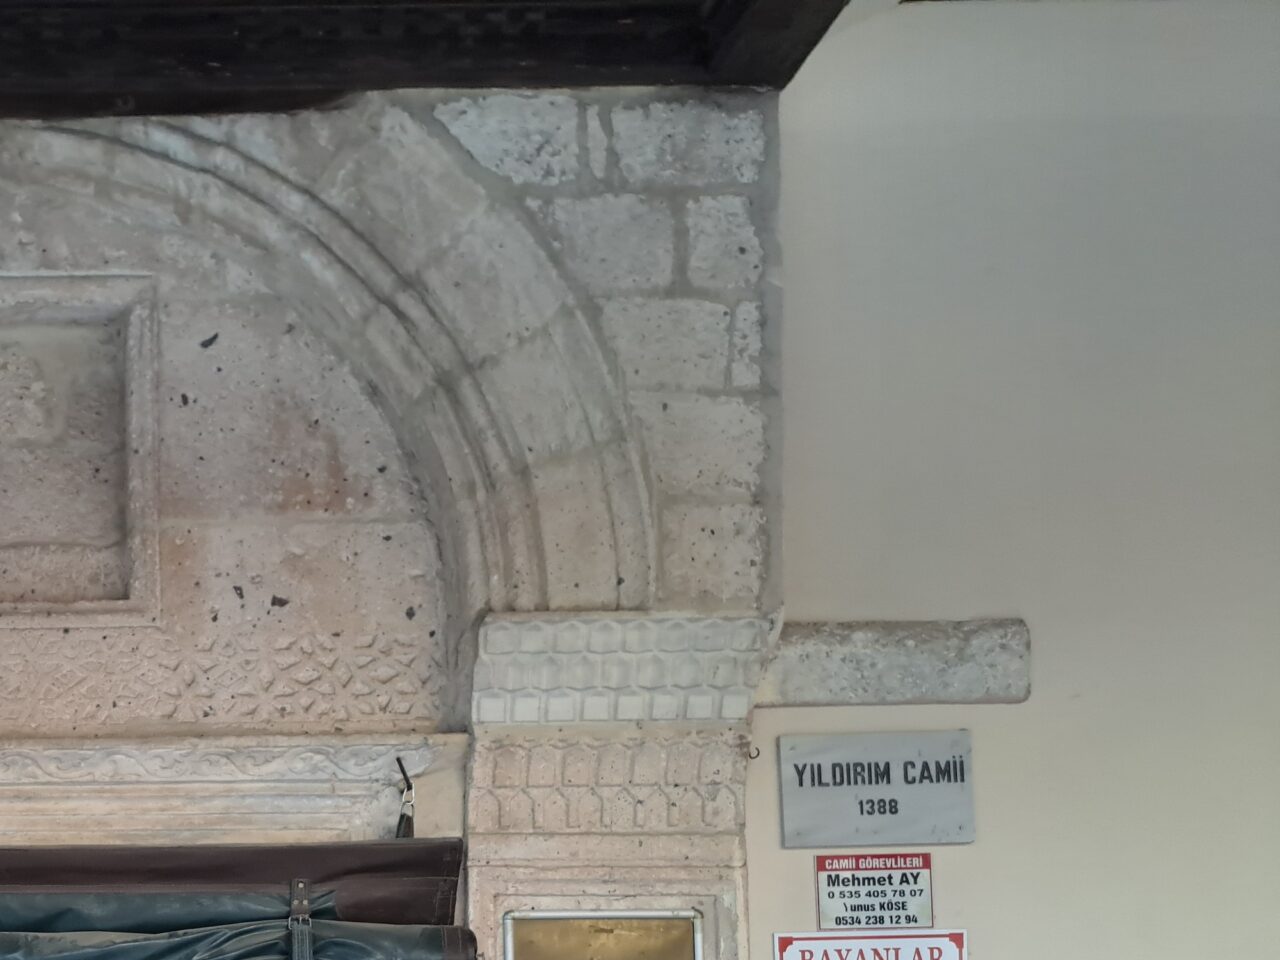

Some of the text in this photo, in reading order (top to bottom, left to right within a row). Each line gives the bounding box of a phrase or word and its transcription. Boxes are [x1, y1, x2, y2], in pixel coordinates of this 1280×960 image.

[793, 755, 965, 787] YILDIRIM CAMİİ
[858, 799, 898, 816] 1388
[859, 856, 922, 869] GÖREVLİLERİ
[827, 872, 921, 887] Mehmet AY
[828, 891, 835, 899] 0
[865, 890, 887, 898] 405
[910, 889, 924, 897] 07
[879, 899, 908, 911] KÖSE
[835, 915, 917, 926] 0534 238 12 94
